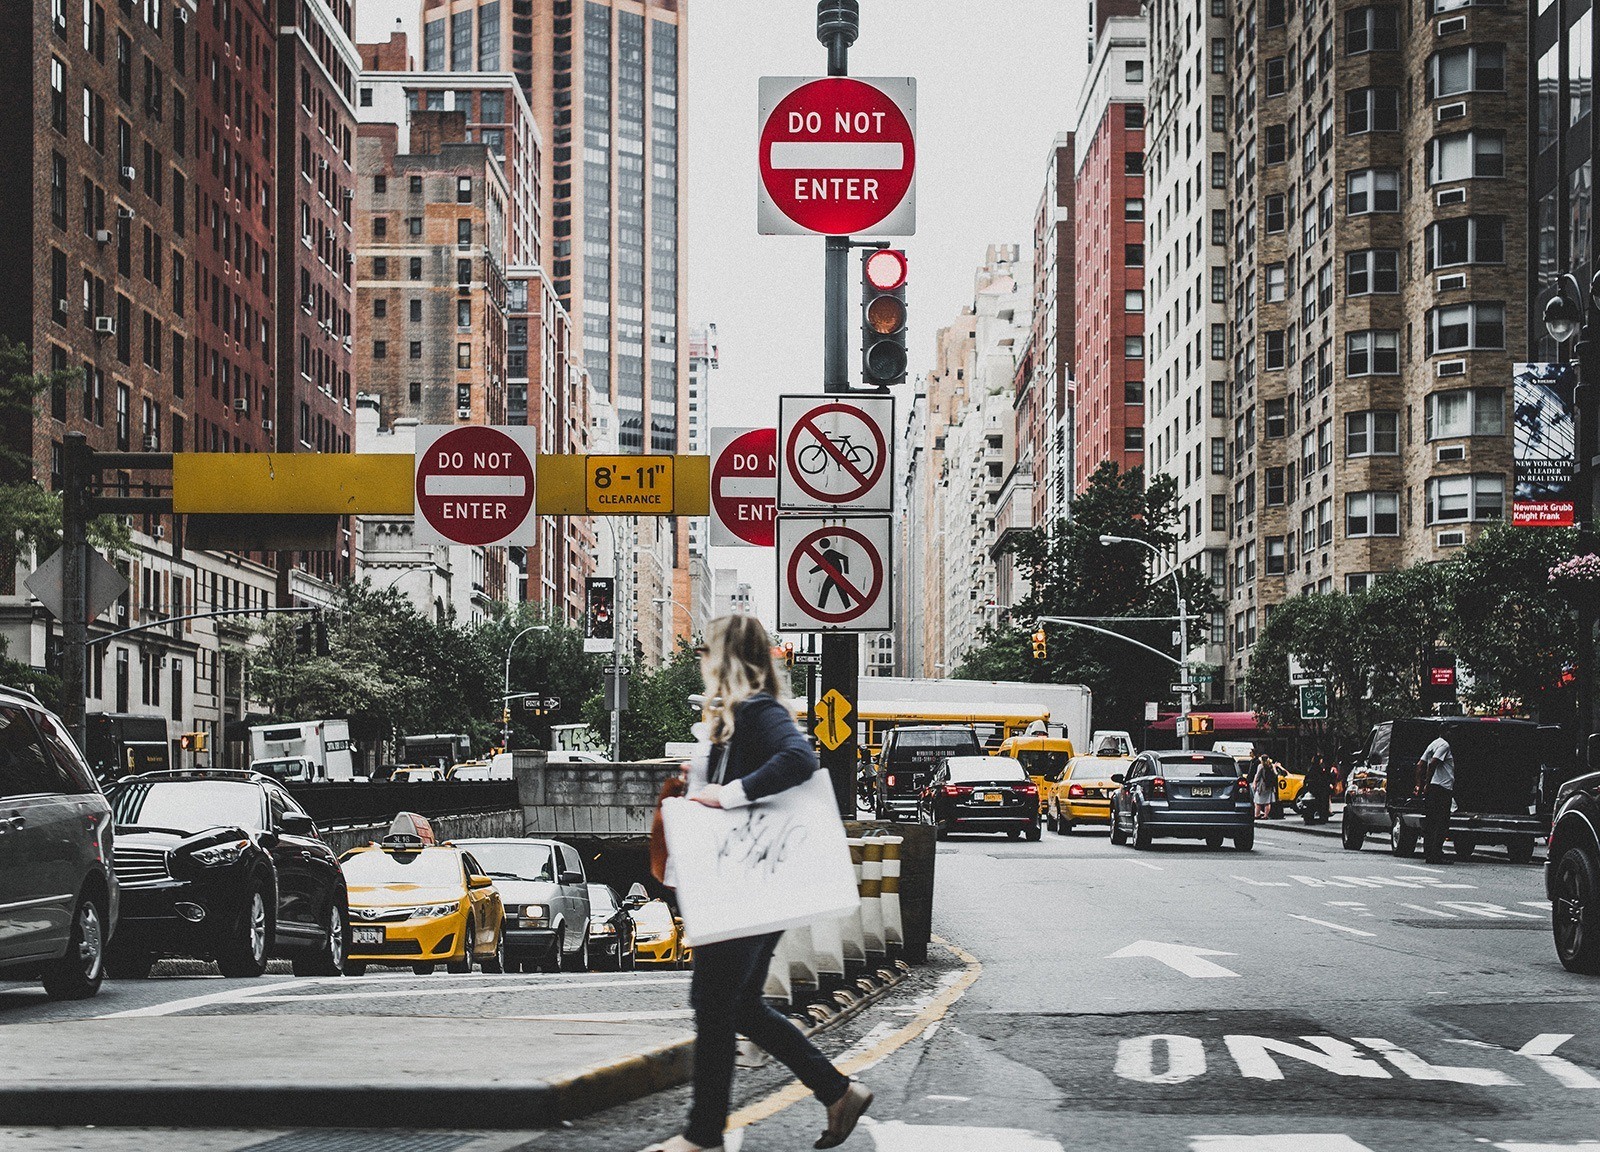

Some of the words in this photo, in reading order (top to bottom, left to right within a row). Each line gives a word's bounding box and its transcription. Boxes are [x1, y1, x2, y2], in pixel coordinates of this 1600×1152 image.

[788, 111, 822, 134] DO
[835, 111, 886, 134] NOT
[794, 178, 879, 200] ENTER
[438, 452, 464, 469] DO
[473, 452, 512, 469] NOT
[733, 453, 758, 471] DO
[598, 494, 662, 504] CLEARANCE
[1513, 503, 1549, 511] Newmark
[1550, 503, 1573, 511] Grubb
[443, 502, 507, 519] ENTER
[738, 504, 776, 520] ENT
[1513, 512, 1538, 521] Knight
[1539, 512, 1560, 520] Frank
[1114, 1033, 1600, 1089] ONLY
